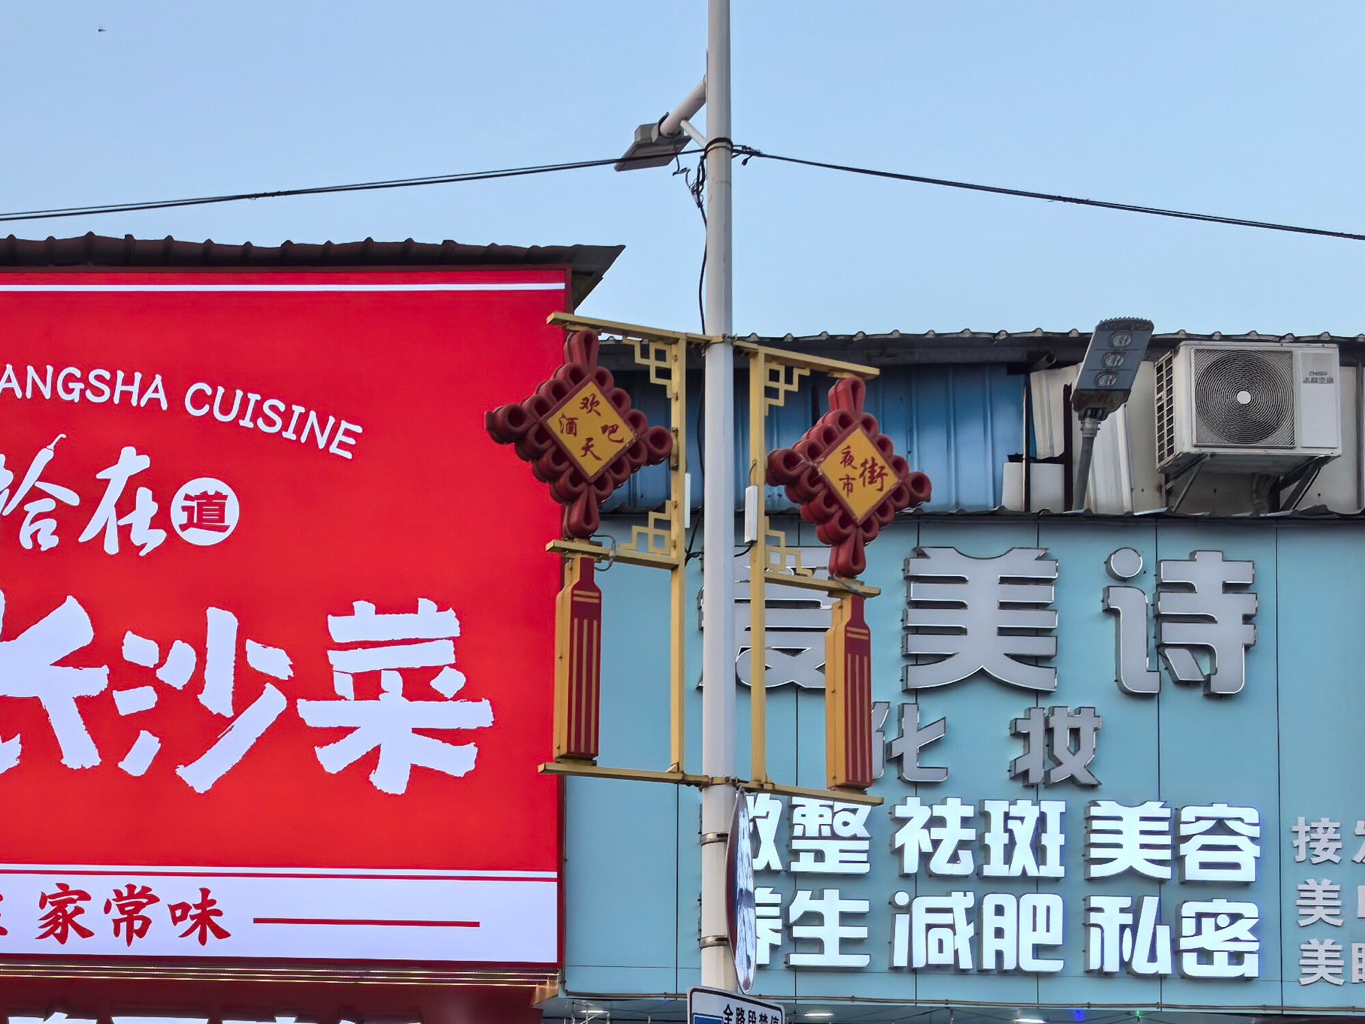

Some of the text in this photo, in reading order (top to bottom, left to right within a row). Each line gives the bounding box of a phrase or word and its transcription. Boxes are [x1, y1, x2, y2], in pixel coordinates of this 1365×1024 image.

[184, 382, 364, 461] CUISINE
[891, 797, 1067, 881] 祛斑
[1085, 801, 1262, 885] 美容
[37, 883, 233, 947] 家常味
[890, 889, 1066, 973] 减肥
[1085, 893, 1262, 981] 私密
[1296, 878, 1365, 927] 美
